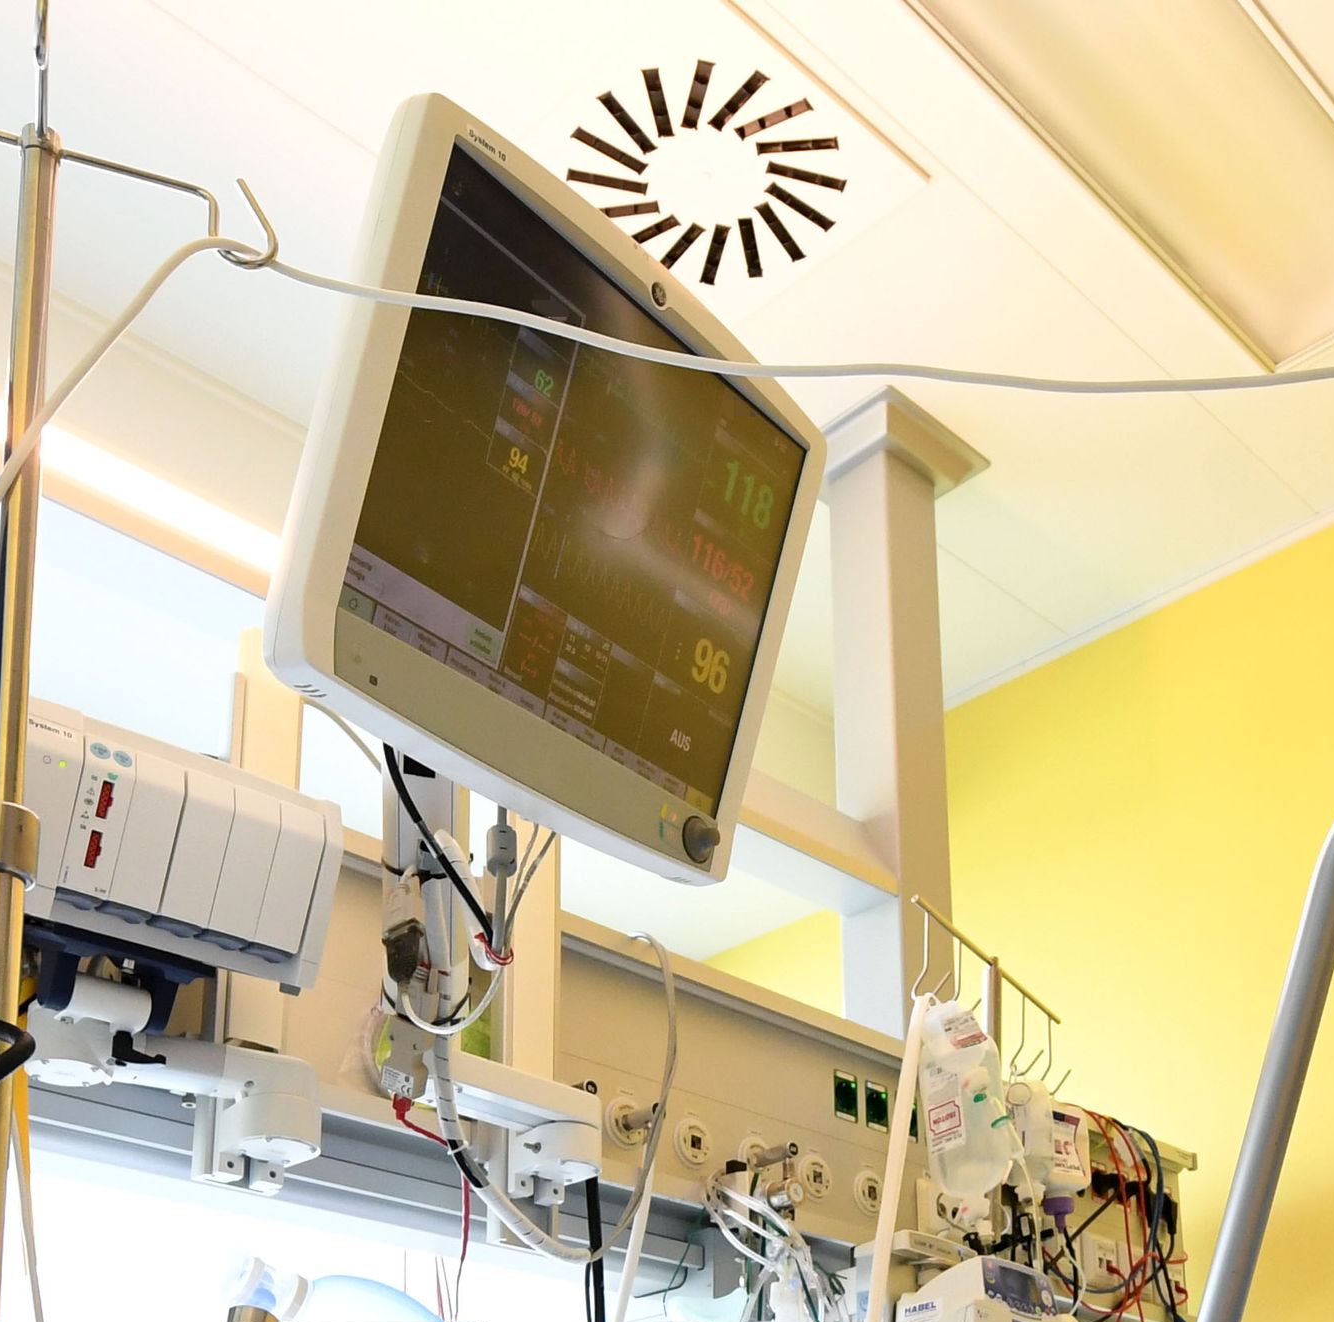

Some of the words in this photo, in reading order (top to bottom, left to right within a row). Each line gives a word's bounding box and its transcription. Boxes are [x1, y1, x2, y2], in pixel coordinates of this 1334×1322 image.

[534, 369, 555, 398] 62
[508, 447, 530, 475] 94
[722, 458, 775, 530] 118
[690, 533, 756, 602] 116/52
[691, 637, 732, 695] 96
[61, 729, 74, 741] 10
[669, 727, 693, 754] AUS
[903, 1301, 937, 1314] HABEL
